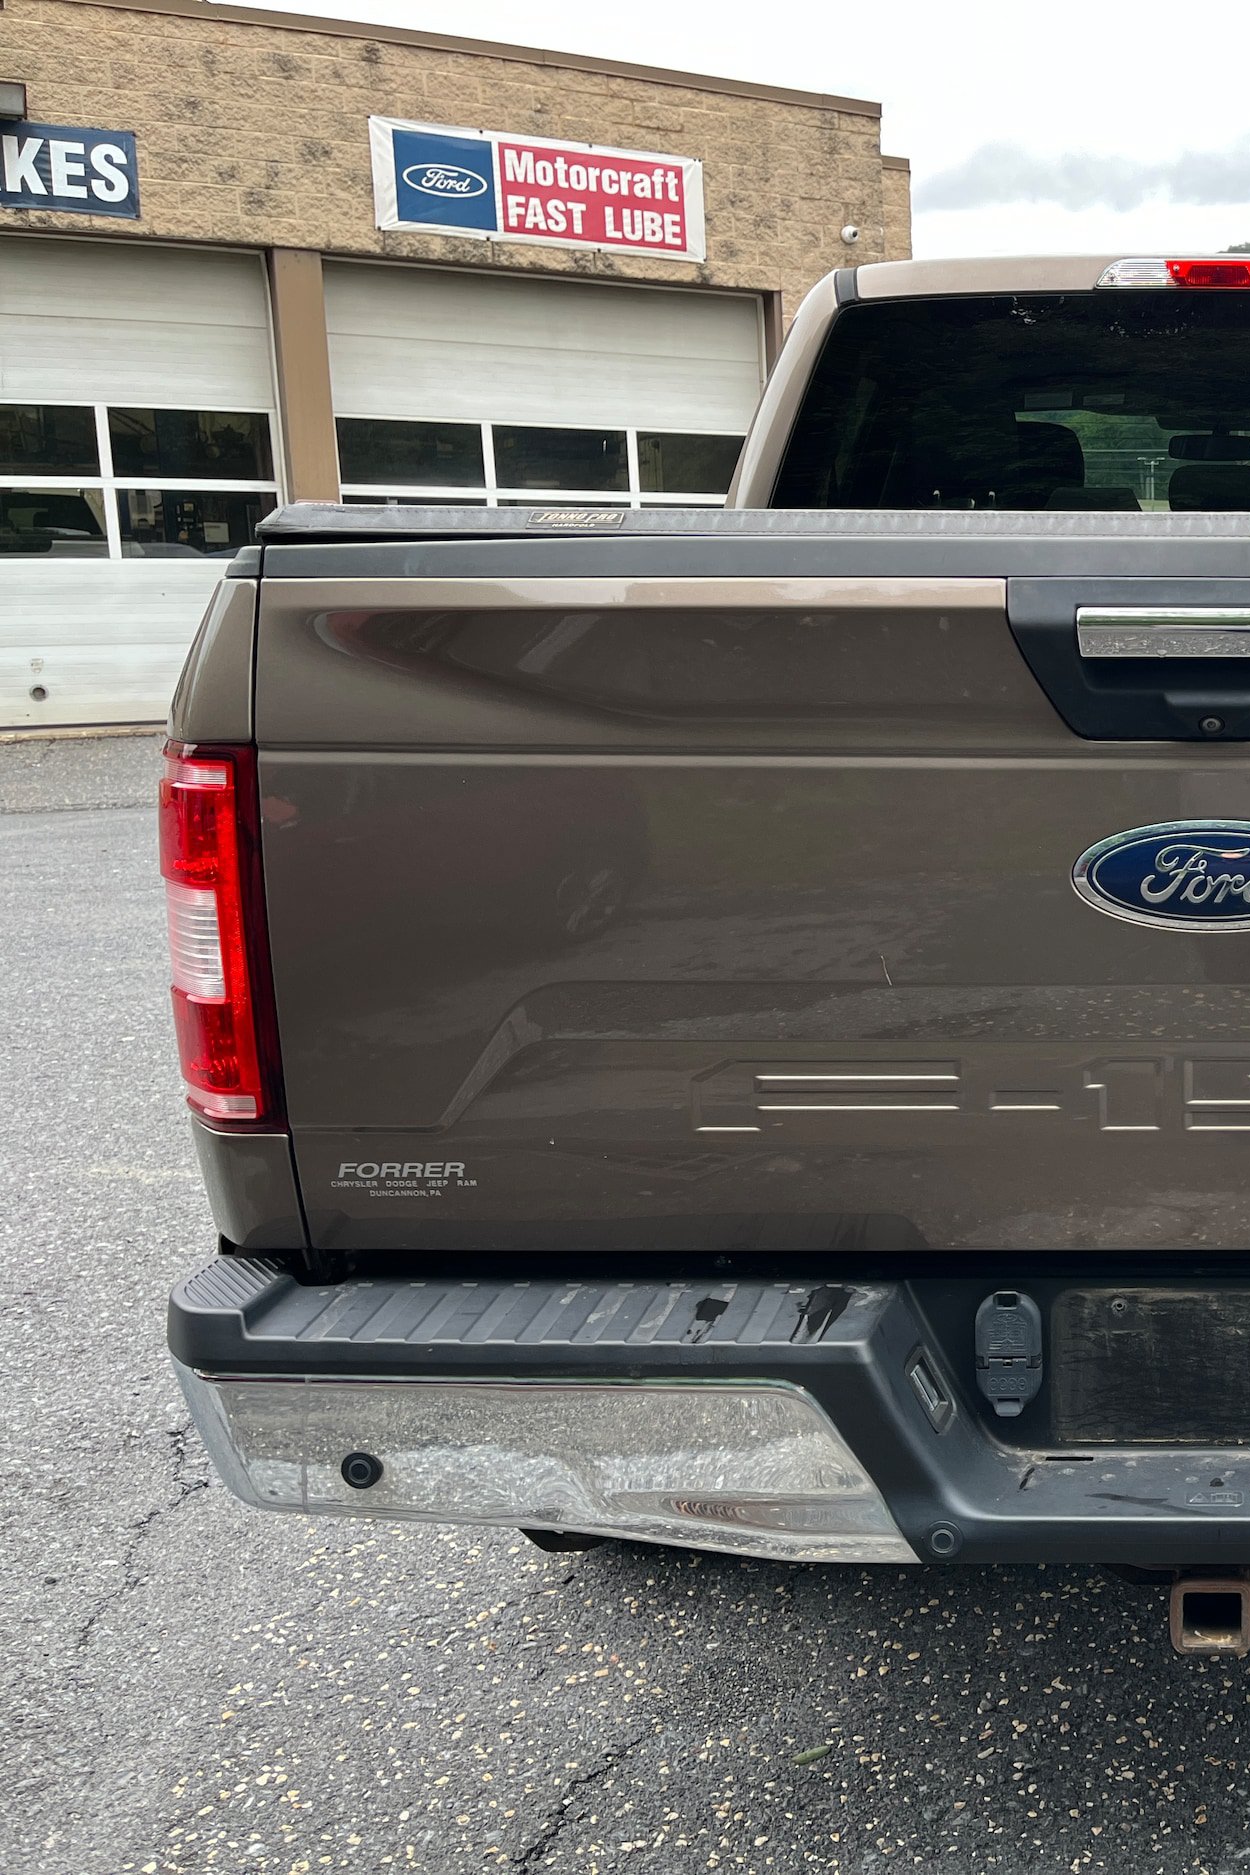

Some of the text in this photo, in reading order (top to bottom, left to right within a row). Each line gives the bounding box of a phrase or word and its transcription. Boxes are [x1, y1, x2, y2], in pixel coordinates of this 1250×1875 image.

[0, 134, 129, 202] KES
[503, 148, 679, 202] Motorcraft
[421, 168, 471, 193] Ford
[506, 194, 683, 246] FAST LUBE
[584, 512, 618, 523] PRO
[338, 1161, 466, 1178] FORRER
[330, 1180, 379, 1188] CHRYSLER
[385, 1180, 418, 1188] DODGE
[457, 1179, 478, 1187] RAM
[369, 1189, 442, 1198] DUNCANNON, PA
